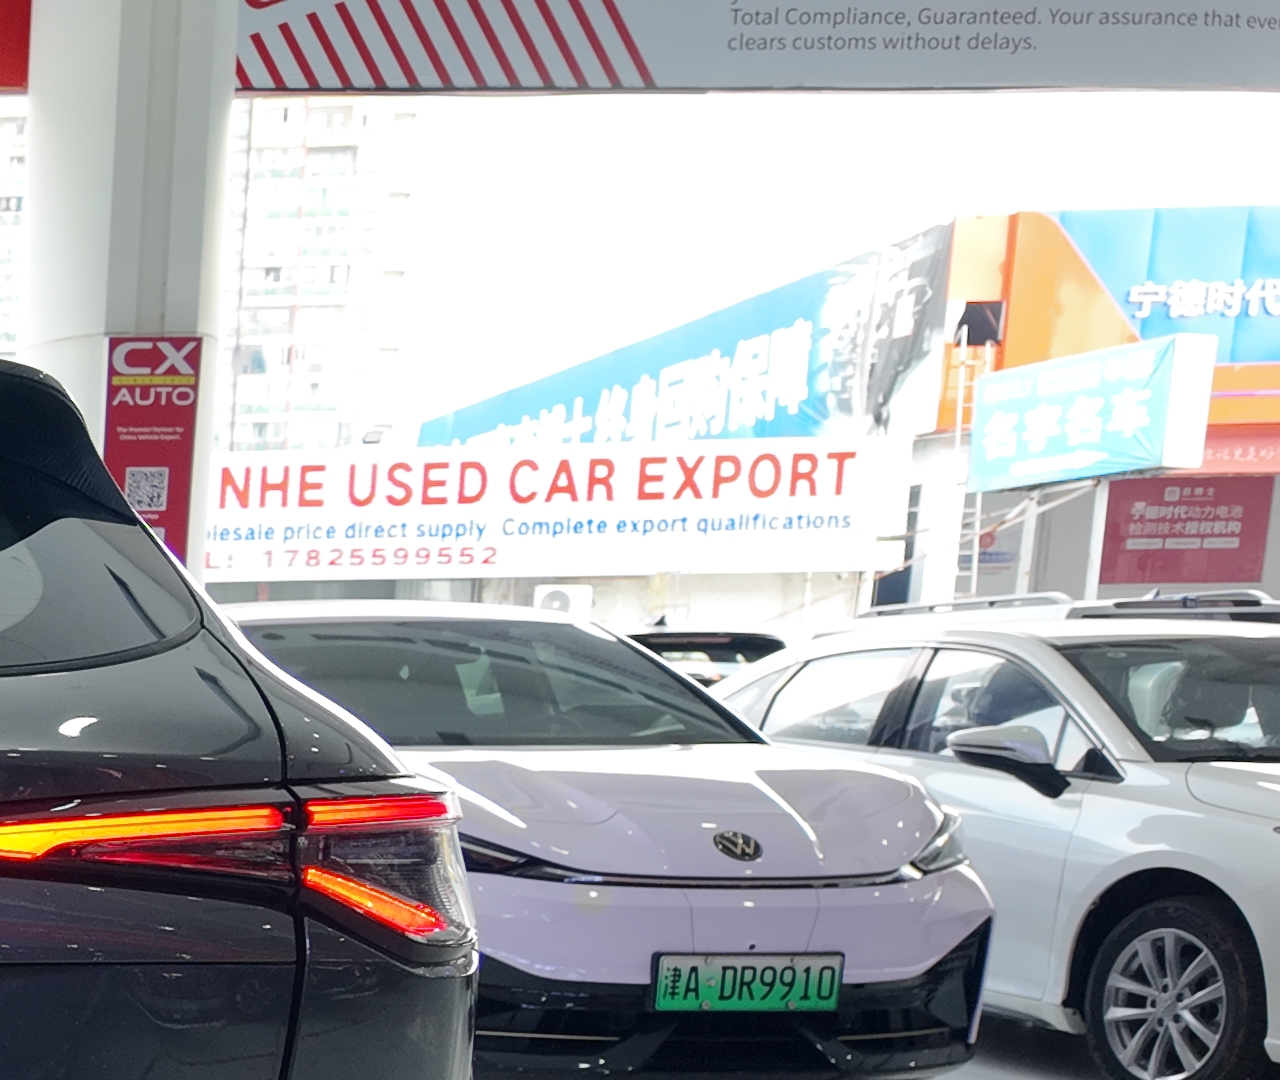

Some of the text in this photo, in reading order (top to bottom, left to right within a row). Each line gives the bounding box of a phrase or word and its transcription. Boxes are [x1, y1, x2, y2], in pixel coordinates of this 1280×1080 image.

[730, 7, 1280, 30] Total Compliance, Guaranteed. Your assurance that eve
[727, 32, 1038, 55] clears customs without delays.
[1129, 279, 1280, 318] 宁德时代
[112, 341, 198, 375] CX
[112, 387, 195, 406] AUTO
[218, 451, 858, 510] NHE USED CAR EXPORT
[283, 522, 337, 544] price
[344, 521, 409, 540] direct
[416, 521, 488, 543] supply
[501, 516, 608, 540] Complete
[616, 515, 689, 537] export
[696, 513, 852, 536] qualifications
[263, 547, 499, 568] 17825599552
